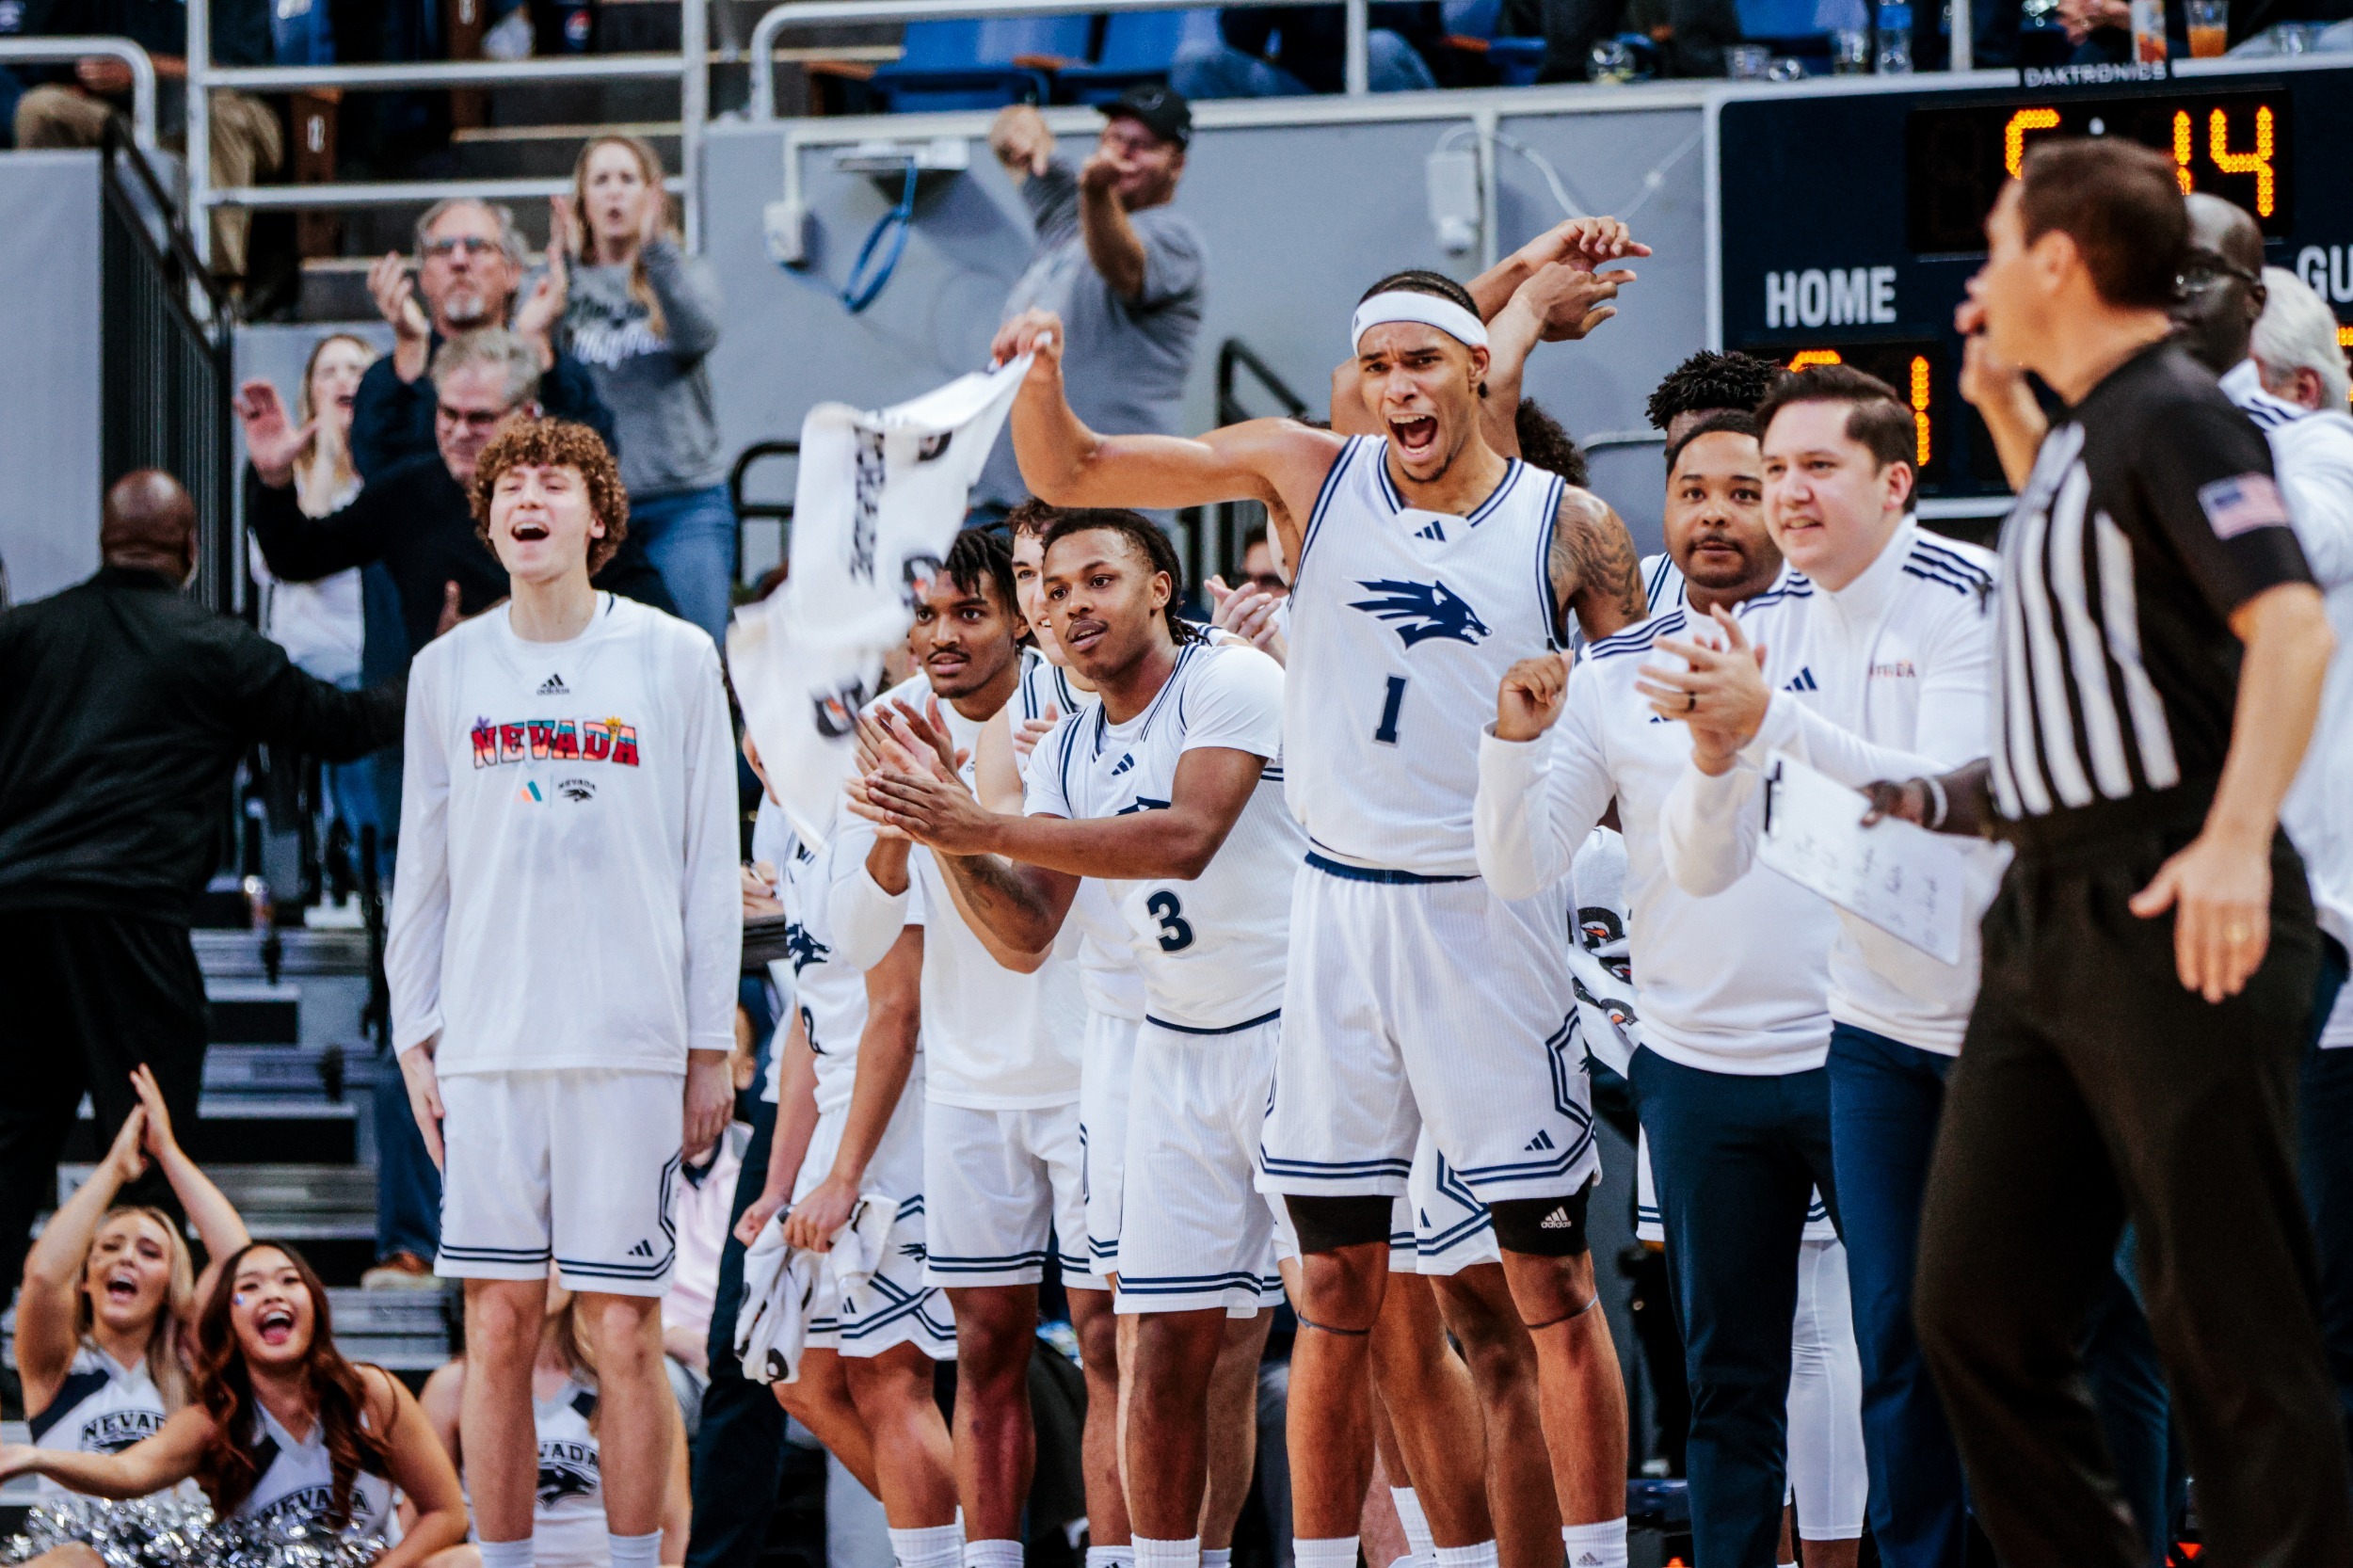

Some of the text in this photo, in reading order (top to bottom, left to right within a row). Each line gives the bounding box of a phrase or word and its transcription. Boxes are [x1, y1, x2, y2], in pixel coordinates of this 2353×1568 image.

[2025, 59, 2167, 88] DAKTRONICS
[1766, 266, 1897, 328] HOME
[536, 686, 570, 696] adidas
[1373, 673, 1410, 748] 1
[471, 719, 640, 770] NEVADA
[558, 777, 597, 791] NEVADA
[1145, 888, 1196, 953] 3
